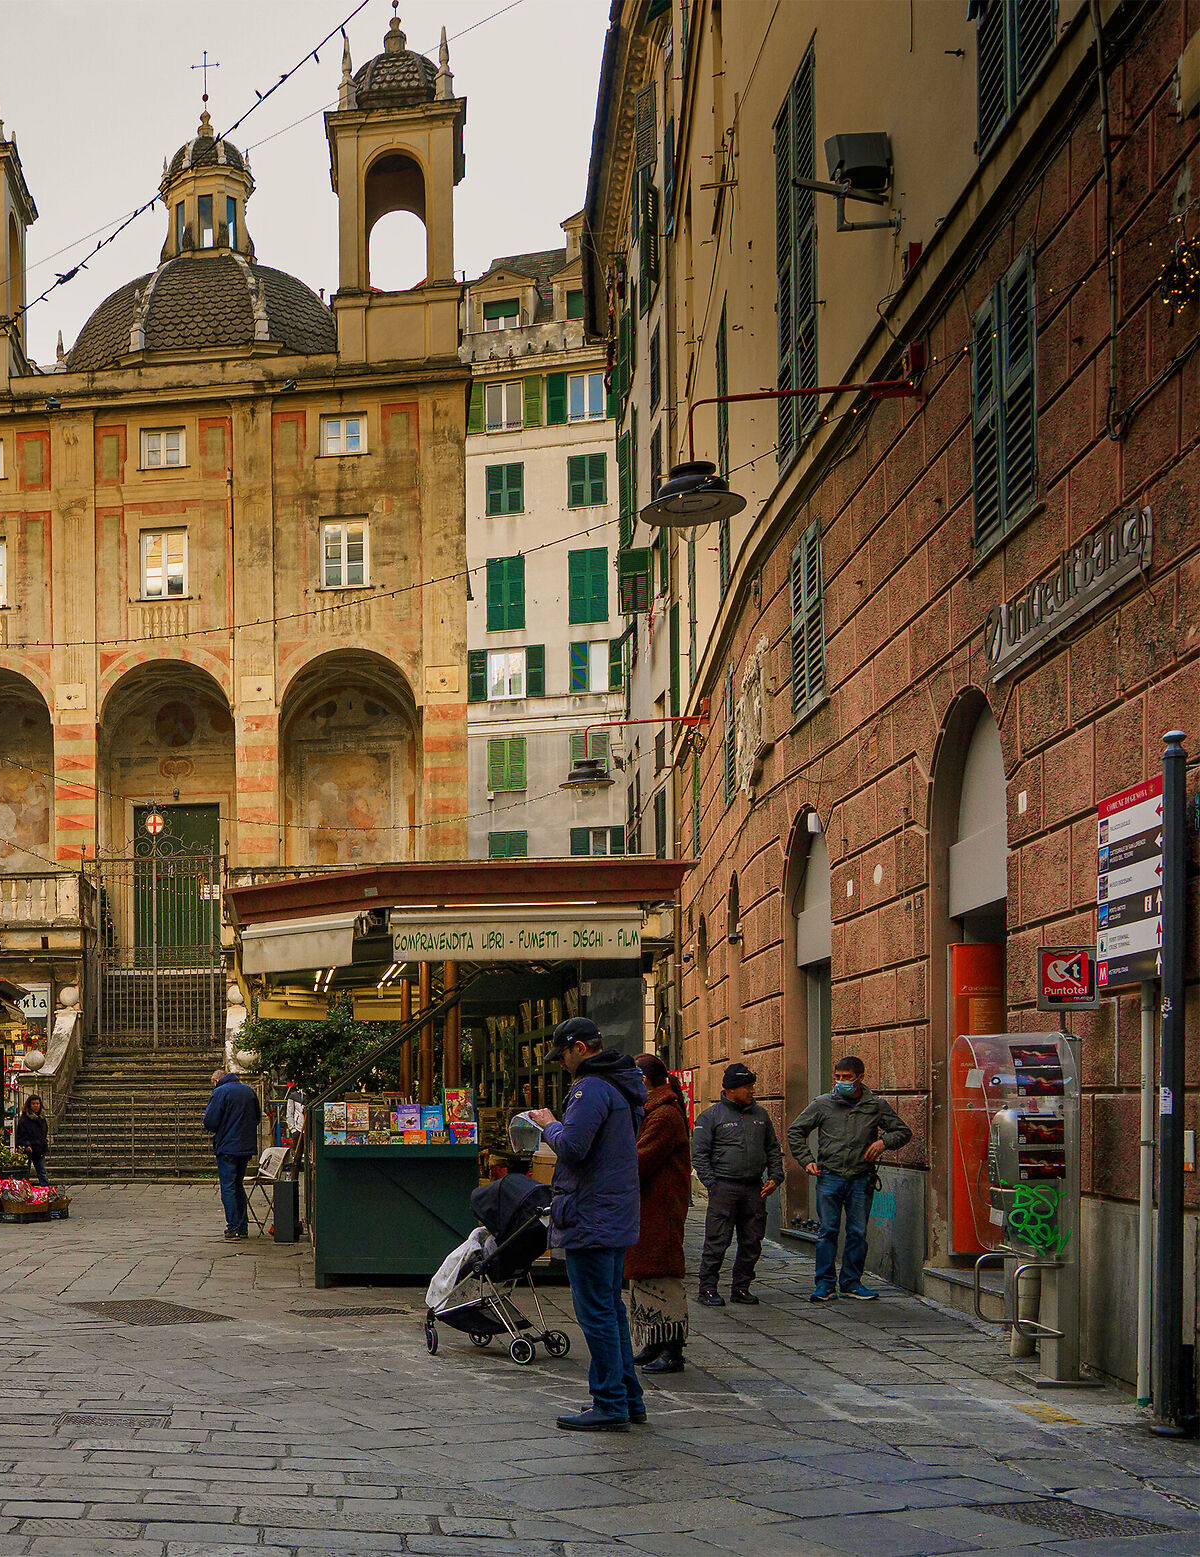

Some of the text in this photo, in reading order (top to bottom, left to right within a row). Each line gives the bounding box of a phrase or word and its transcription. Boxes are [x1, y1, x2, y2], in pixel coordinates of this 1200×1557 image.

[1006, 506, 1143, 646] UniCredit Banca
[1107, 799, 1124, 812] COMUNE
[1129, 789, 1148, 802] GENOVA
[394, 931, 474, 951] COMPRAVENDITA
[481, 930, 505, 949] LIBRI
[518, 929, 560, 949] FUMETTI
[572, 928, 604, 948] DISCHI
[617, 928, 640, 947] FILM
[1044, 986, 1088, 995] Puntotel
